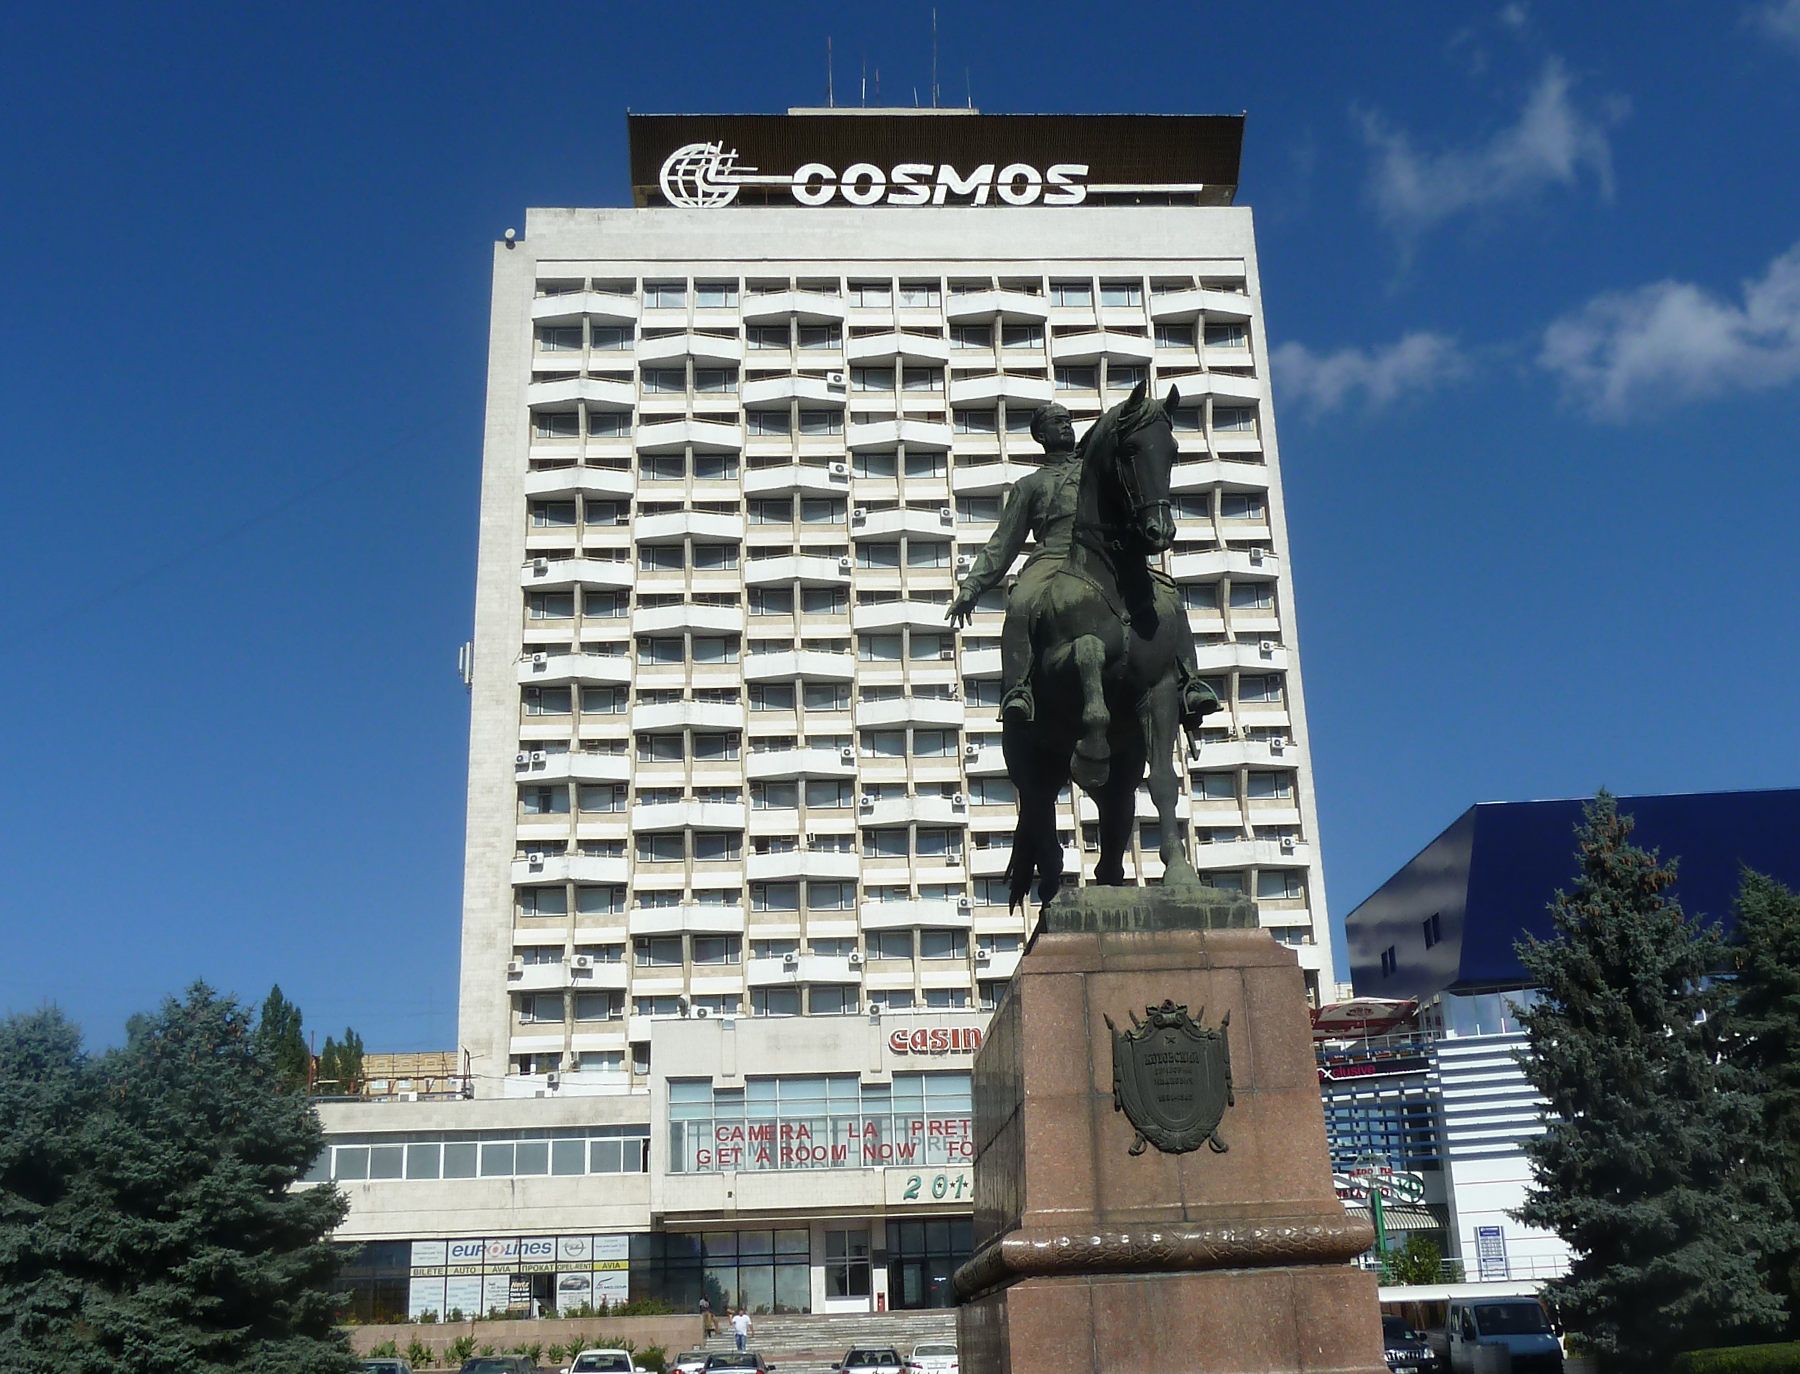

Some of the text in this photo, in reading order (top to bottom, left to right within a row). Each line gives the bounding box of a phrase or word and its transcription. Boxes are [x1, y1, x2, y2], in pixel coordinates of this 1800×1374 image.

[791, 162, 1089, 206] COSMOS
[715, 1123, 812, 1141] CAMERA
[848, 1121, 878, 1138] LA
[696, 1146, 743, 1164] GET
[755, 1147, 771, 1163] A
[780, 1144, 847, 1162] ROOM
[862, 1143, 917, 1160] NOW
[903, 1173, 975, 1200] 201
[453, 1266, 477, 1274] AUTO
[492, 1265, 511, 1273] AVIA
[602, 1261, 621, 1270] AVIA
